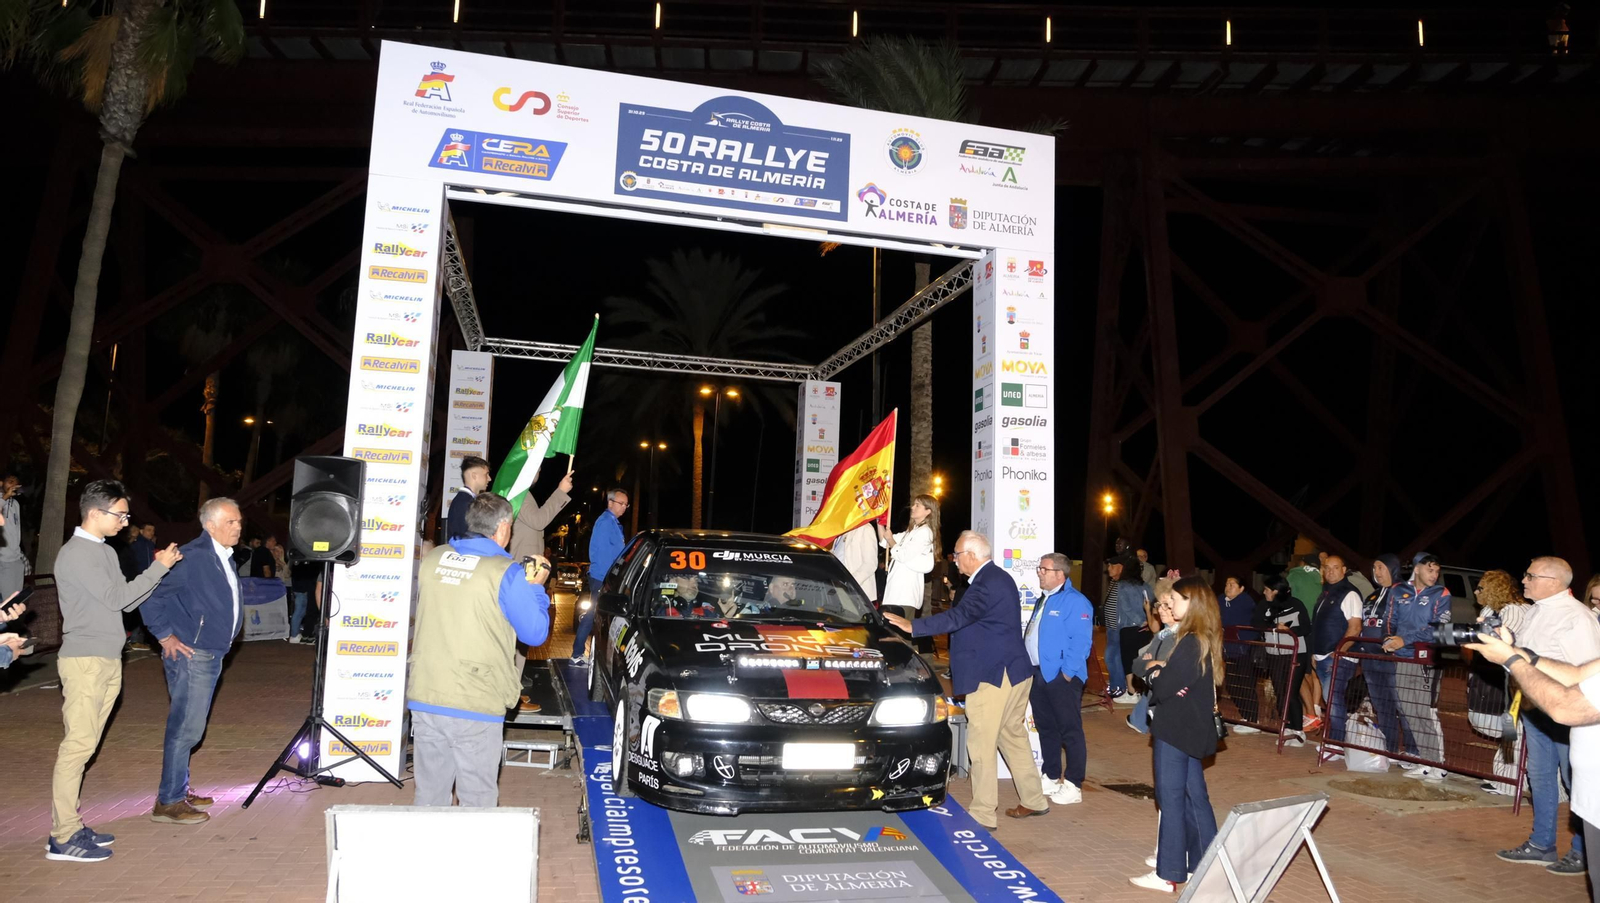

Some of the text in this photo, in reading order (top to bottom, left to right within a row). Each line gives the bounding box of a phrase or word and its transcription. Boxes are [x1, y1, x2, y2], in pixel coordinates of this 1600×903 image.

[640, 128, 829, 174] 50 RALLYE
[494, 159, 537, 175] Recalvi
[639, 155, 826, 190] COSTA DE ALMERÍA
[391, 205, 430, 213] MICHELIN
[889, 198, 937, 212] COSTA DE
[878, 208, 938, 226] ALMERÍA
[973, 210, 1037, 226] DIPUTACIÓN
[973, 220, 1035, 237] DE ALMERÍA
[374, 242, 428, 258] Rallycar
[380, 268, 416, 280] Recalvi
[383, 294, 423, 302] MICHELIN
[366, 332, 420, 347] Rallycar
[372, 359, 409, 370] Recalvi
[1001, 415, 1048, 428] gasolia
[358, 423, 412, 438] Rallycar
[363, 450, 400, 461] Recalvi
[1002, 466, 1047, 481] Phonika
[361, 518, 404, 531] allycar
[670, 550, 706, 570] 30
[743, 552, 792, 561] MURCIA
[342, 615, 398, 629] Rallycar
[703, 633, 866, 647] MURCIA
[348, 643, 386, 653] Recalvi
[334, 715, 391, 728] Rallycar
[628, 750, 659, 772] DESGUACE
[638, 772, 660, 789] PARÍS
[716, 843, 779, 851] FEDERACIÓN
[781, 869, 908, 883] DIPUTACIÓN
[790, 878, 914, 892] DE ALMERÍA
